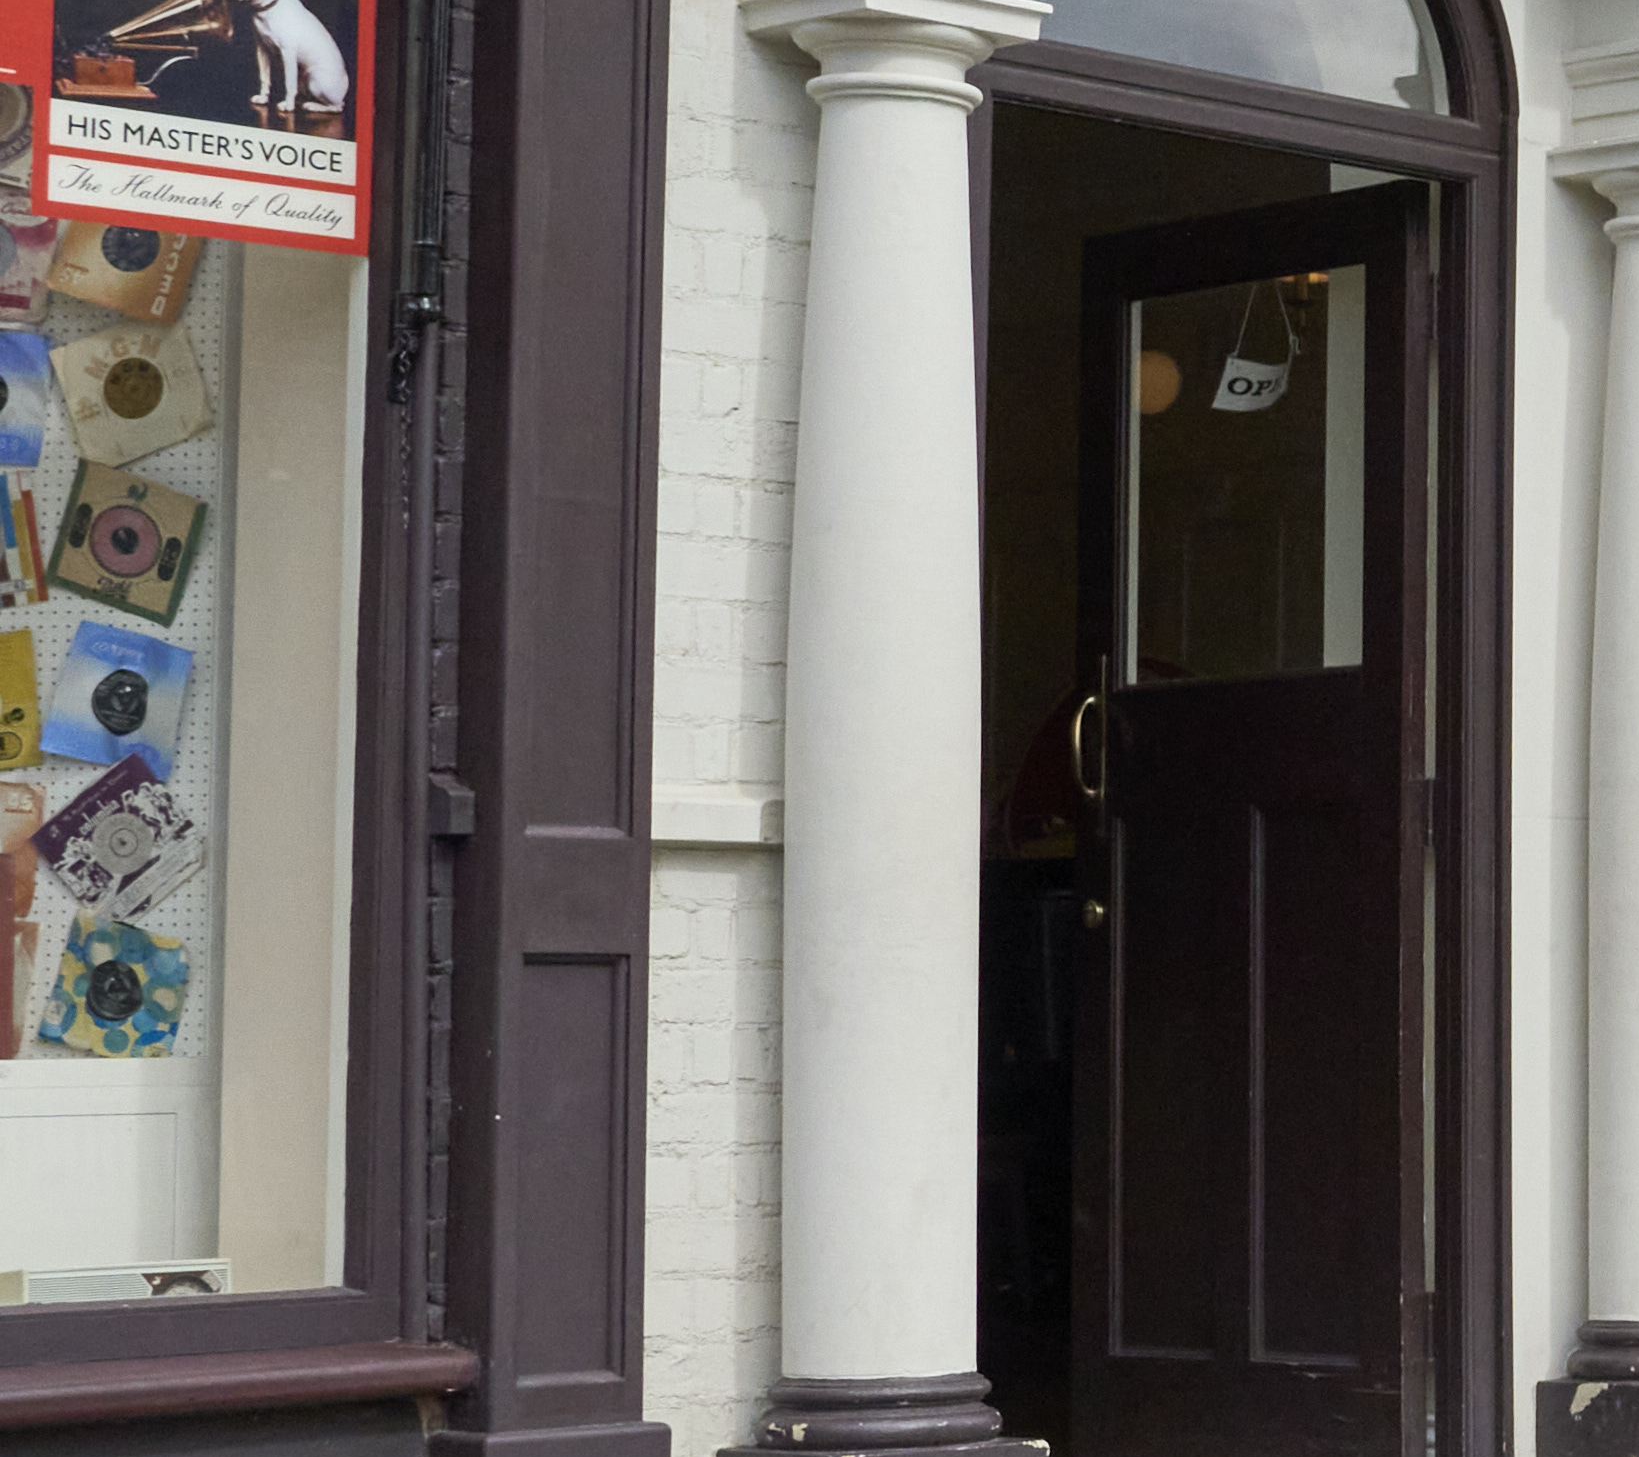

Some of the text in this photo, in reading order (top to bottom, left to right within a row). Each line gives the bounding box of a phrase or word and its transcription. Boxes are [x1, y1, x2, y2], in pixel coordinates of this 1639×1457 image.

[67, 113, 343, 173] HIS MASTER'S VOICE
[57, 164, 343, 231] The Hallmark of Quality
